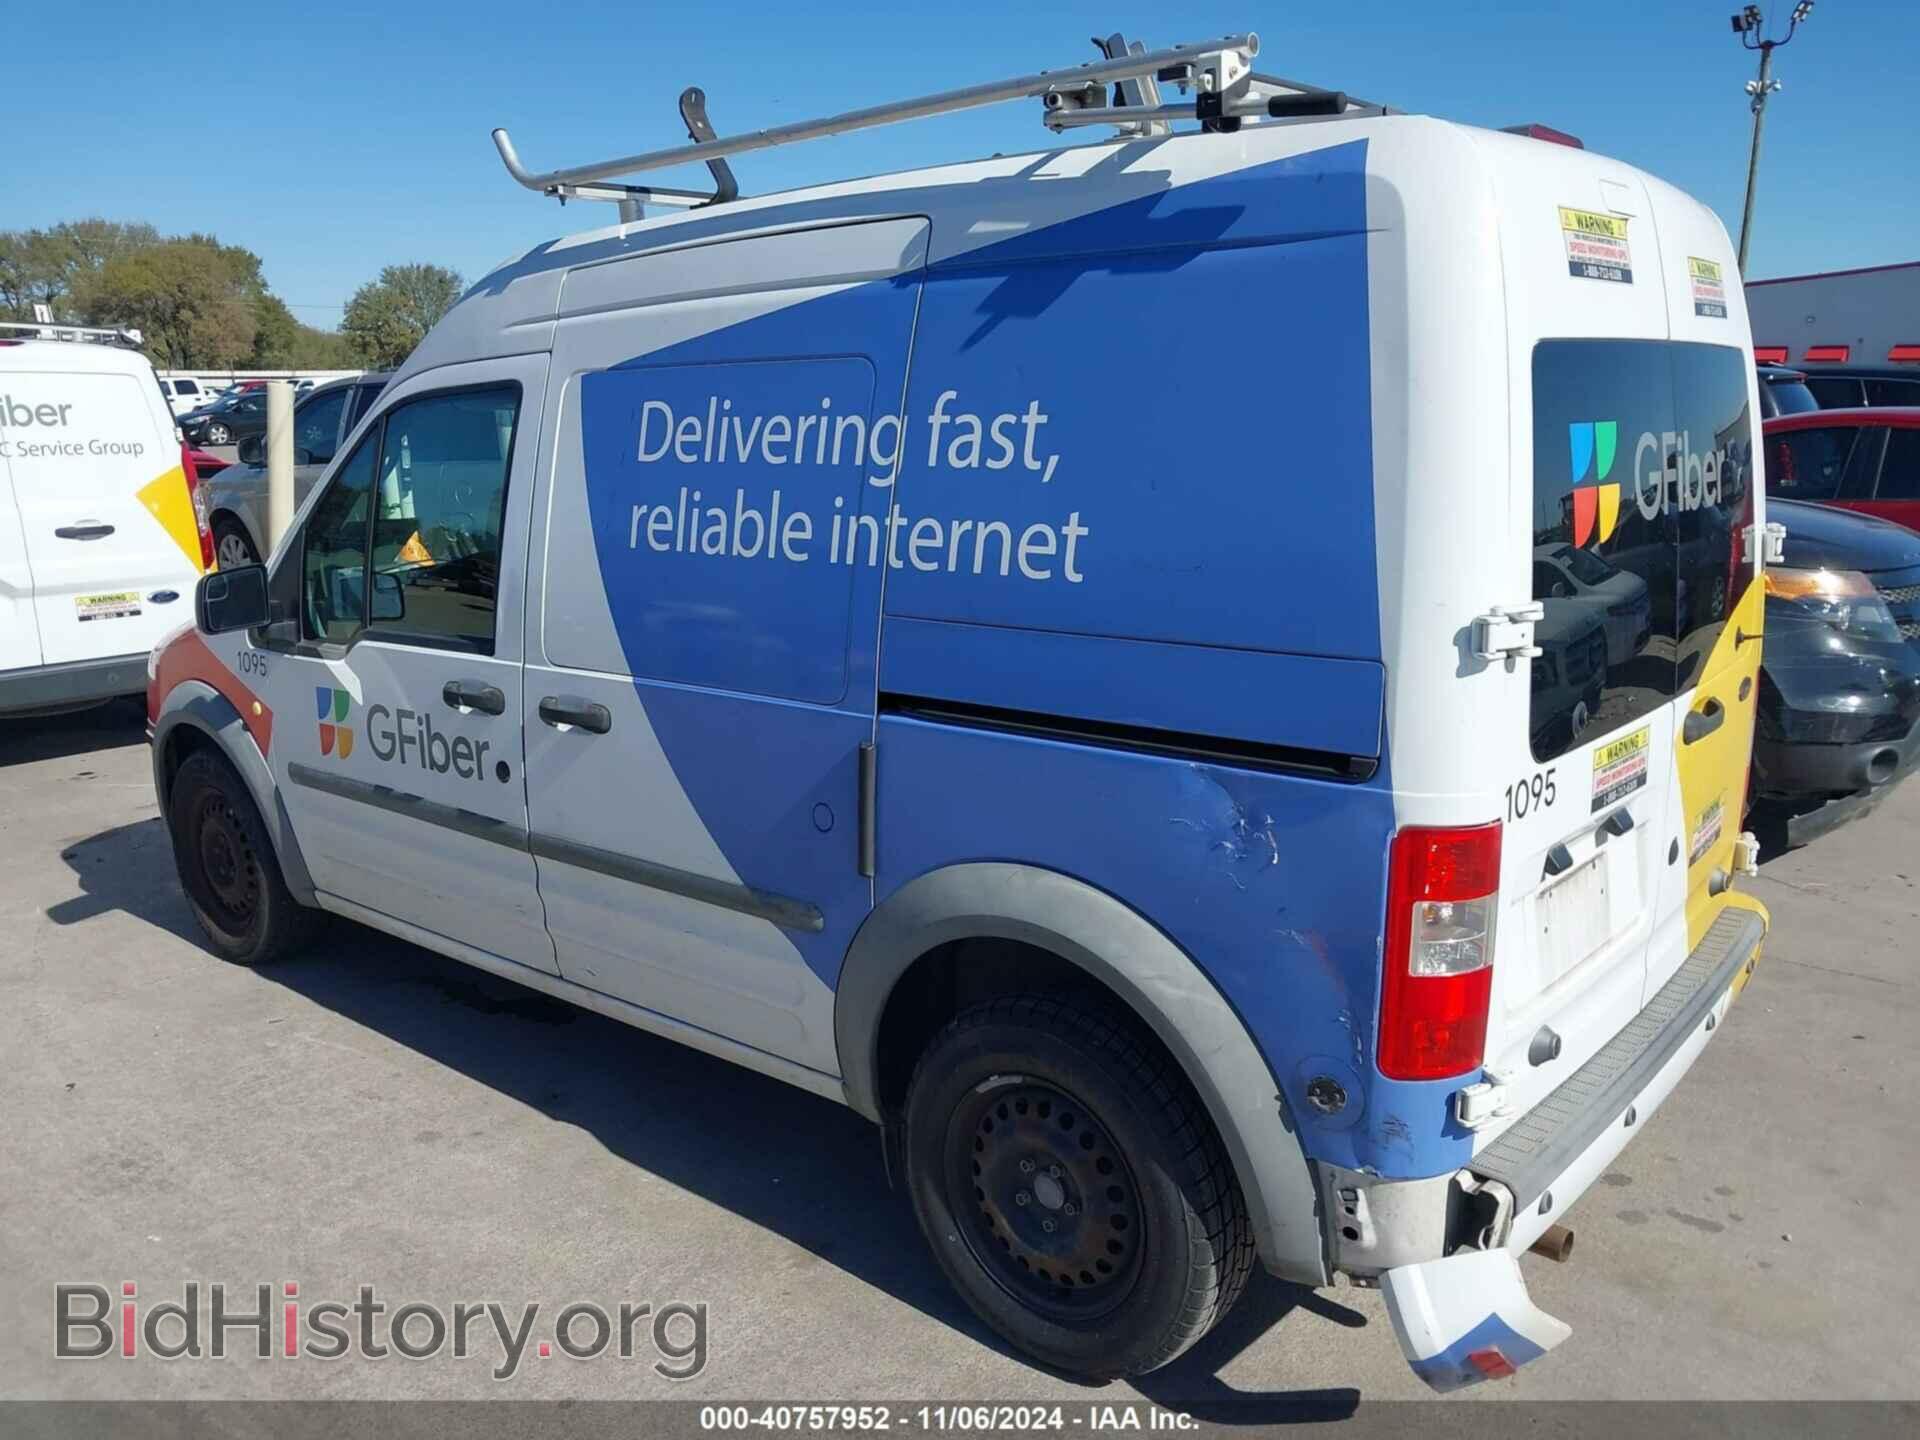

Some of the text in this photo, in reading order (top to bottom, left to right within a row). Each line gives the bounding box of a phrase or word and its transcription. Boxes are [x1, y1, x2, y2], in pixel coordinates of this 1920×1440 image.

[1575, 213, 1615, 235] WARNING
[16, 440, 84, 457] Service
[88, 438, 145, 459] Group
[637, 390, 1061, 488] Delivering fast,
[1634, 430, 1726, 521] GFiber
[629, 487, 1089, 583] reliable internet
[237, 651, 269, 677] 1095
[366, 703, 491, 781] GFiber
[1606, 734, 1640, 762] WARNING
[1505, 767, 1556, 823] 1095
